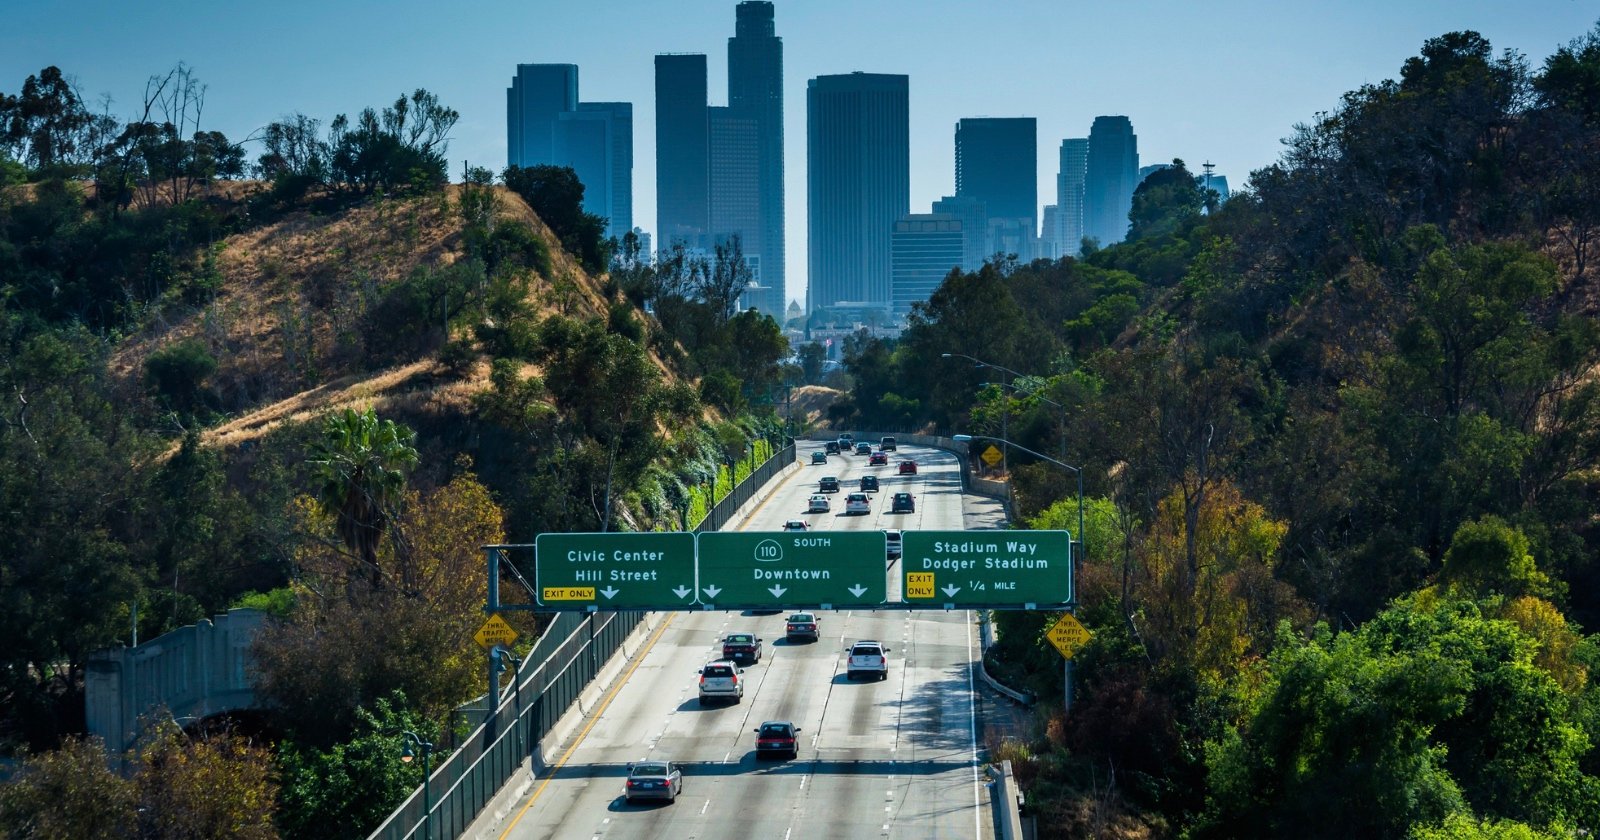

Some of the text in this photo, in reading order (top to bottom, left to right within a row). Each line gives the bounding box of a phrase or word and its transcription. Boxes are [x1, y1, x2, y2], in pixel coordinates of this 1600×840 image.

[794, 538, 831, 547] SOUTH
[934, 541, 1037, 555] Stadium Way
[567, 550, 664, 562] Civic Center
[761, 546, 777, 557] 110
[923, 558, 1048, 572] Dodger Stadium
[575, 570, 657, 581] Hill Street
[754, 568, 830, 580] Downtown
[909, 575, 932, 583] EXIT
[908, 587, 933, 595] ONLY
[994, 582, 1016, 590] MILE
